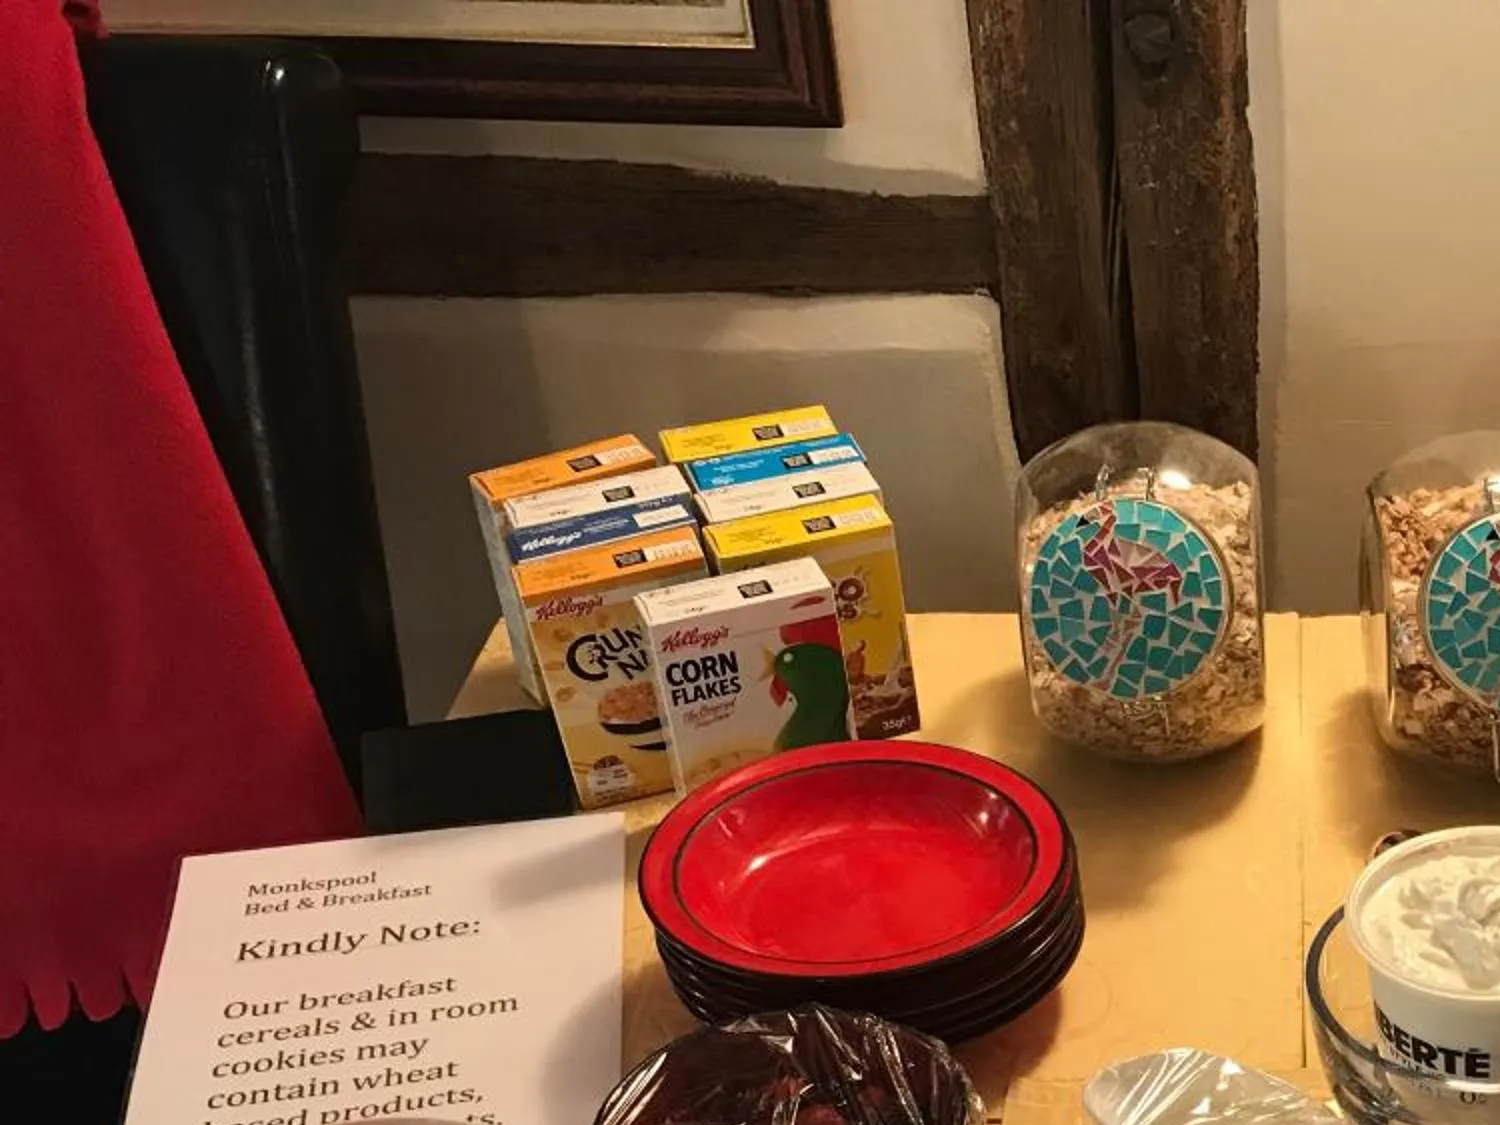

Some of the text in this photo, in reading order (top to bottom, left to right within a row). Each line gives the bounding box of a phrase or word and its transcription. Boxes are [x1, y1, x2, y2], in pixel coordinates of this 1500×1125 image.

[566, 625, 641, 682] CRUN
[660, 625, 729, 653] Kellogg's
[665, 651, 739, 687] CORN
[671, 676, 742, 706] FLAKES
[244, 884, 432, 916] Bed & Breakfast
[247, 871, 377, 898] Monkspool
[236, 918, 481, 962] Kindly Note:
[223, 976, 458, 1020] Our breakfast
[217, 995, 519, 1049] cereals & in room
[1374, 1000, 1491, 1078] BERTÉ
[212, 1037, 429, 1078] cookies may
[207, 1060, 460, 1110] contain wheat
